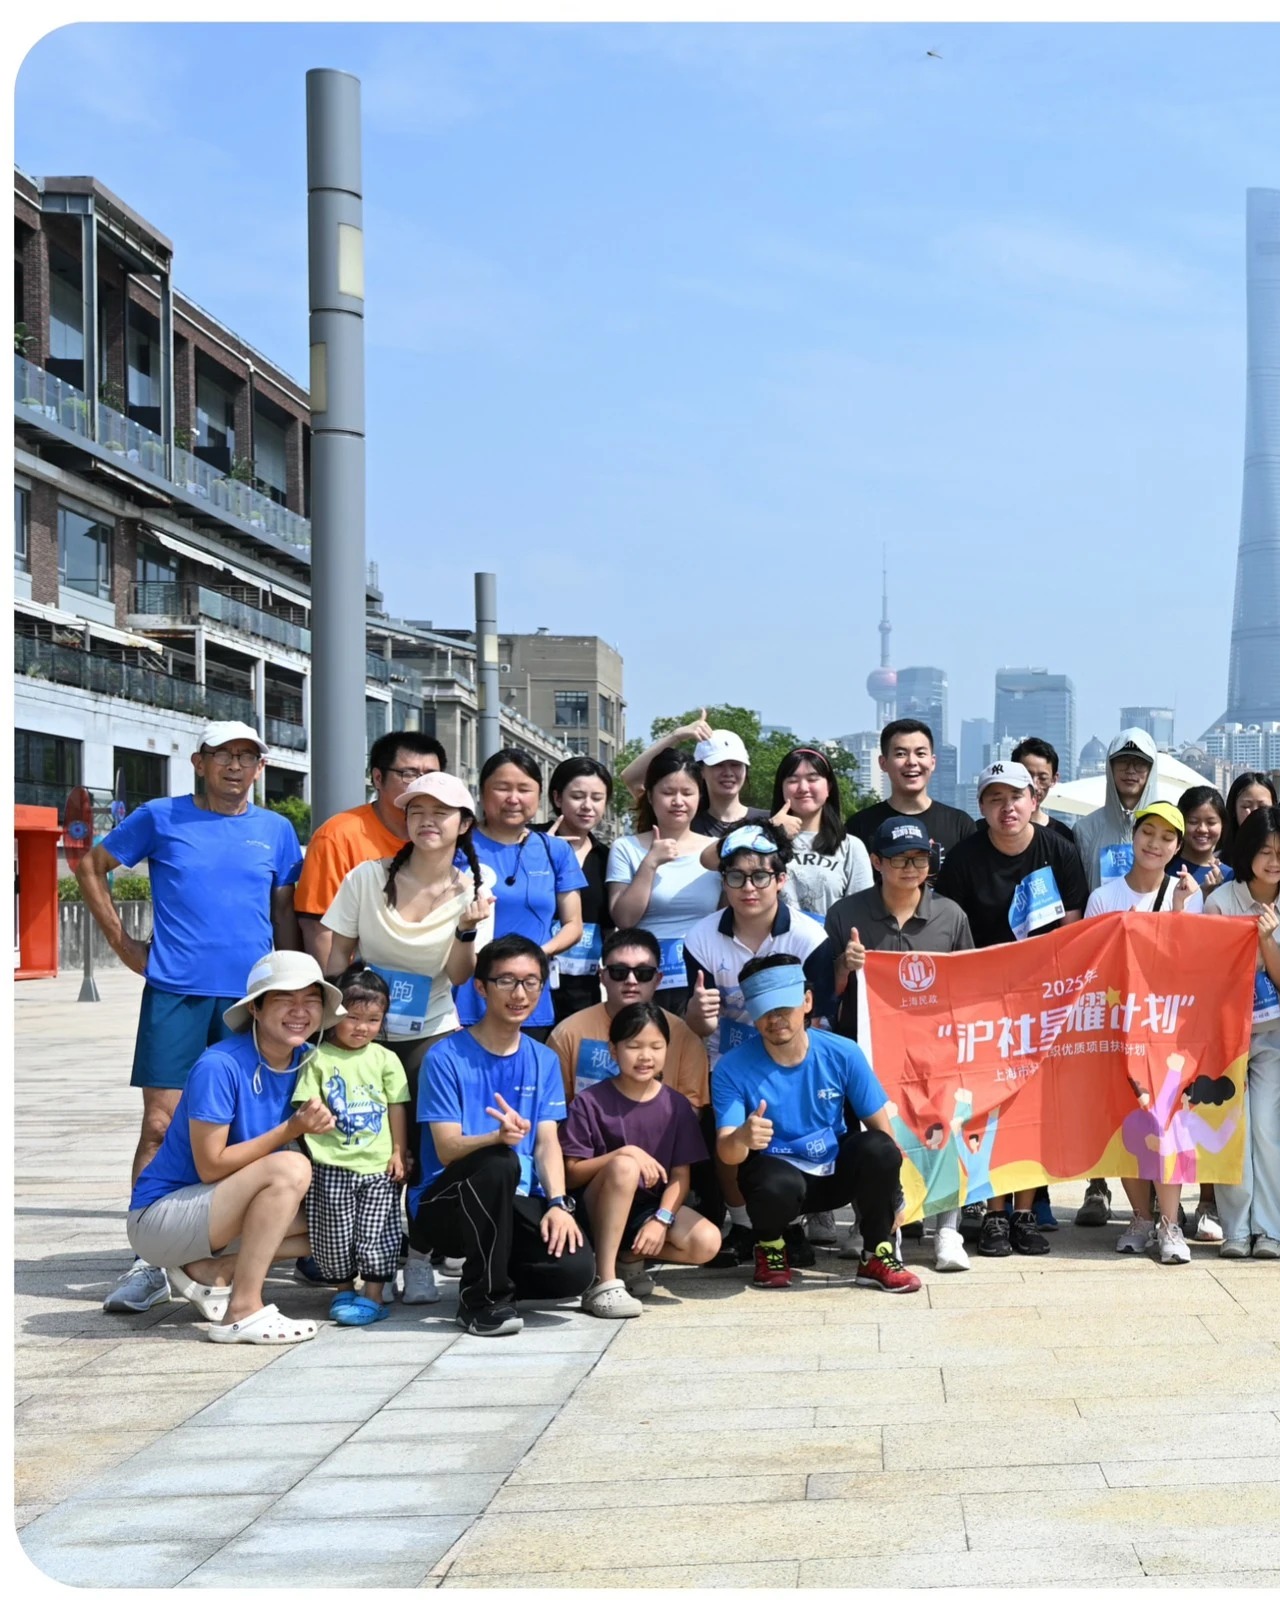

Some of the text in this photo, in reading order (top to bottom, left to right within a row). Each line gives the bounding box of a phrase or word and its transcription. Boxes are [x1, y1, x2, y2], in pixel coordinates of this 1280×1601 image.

[1042, 968, 1098, 999] 2025年
[899, 995, 939, 1009] 上海民政
